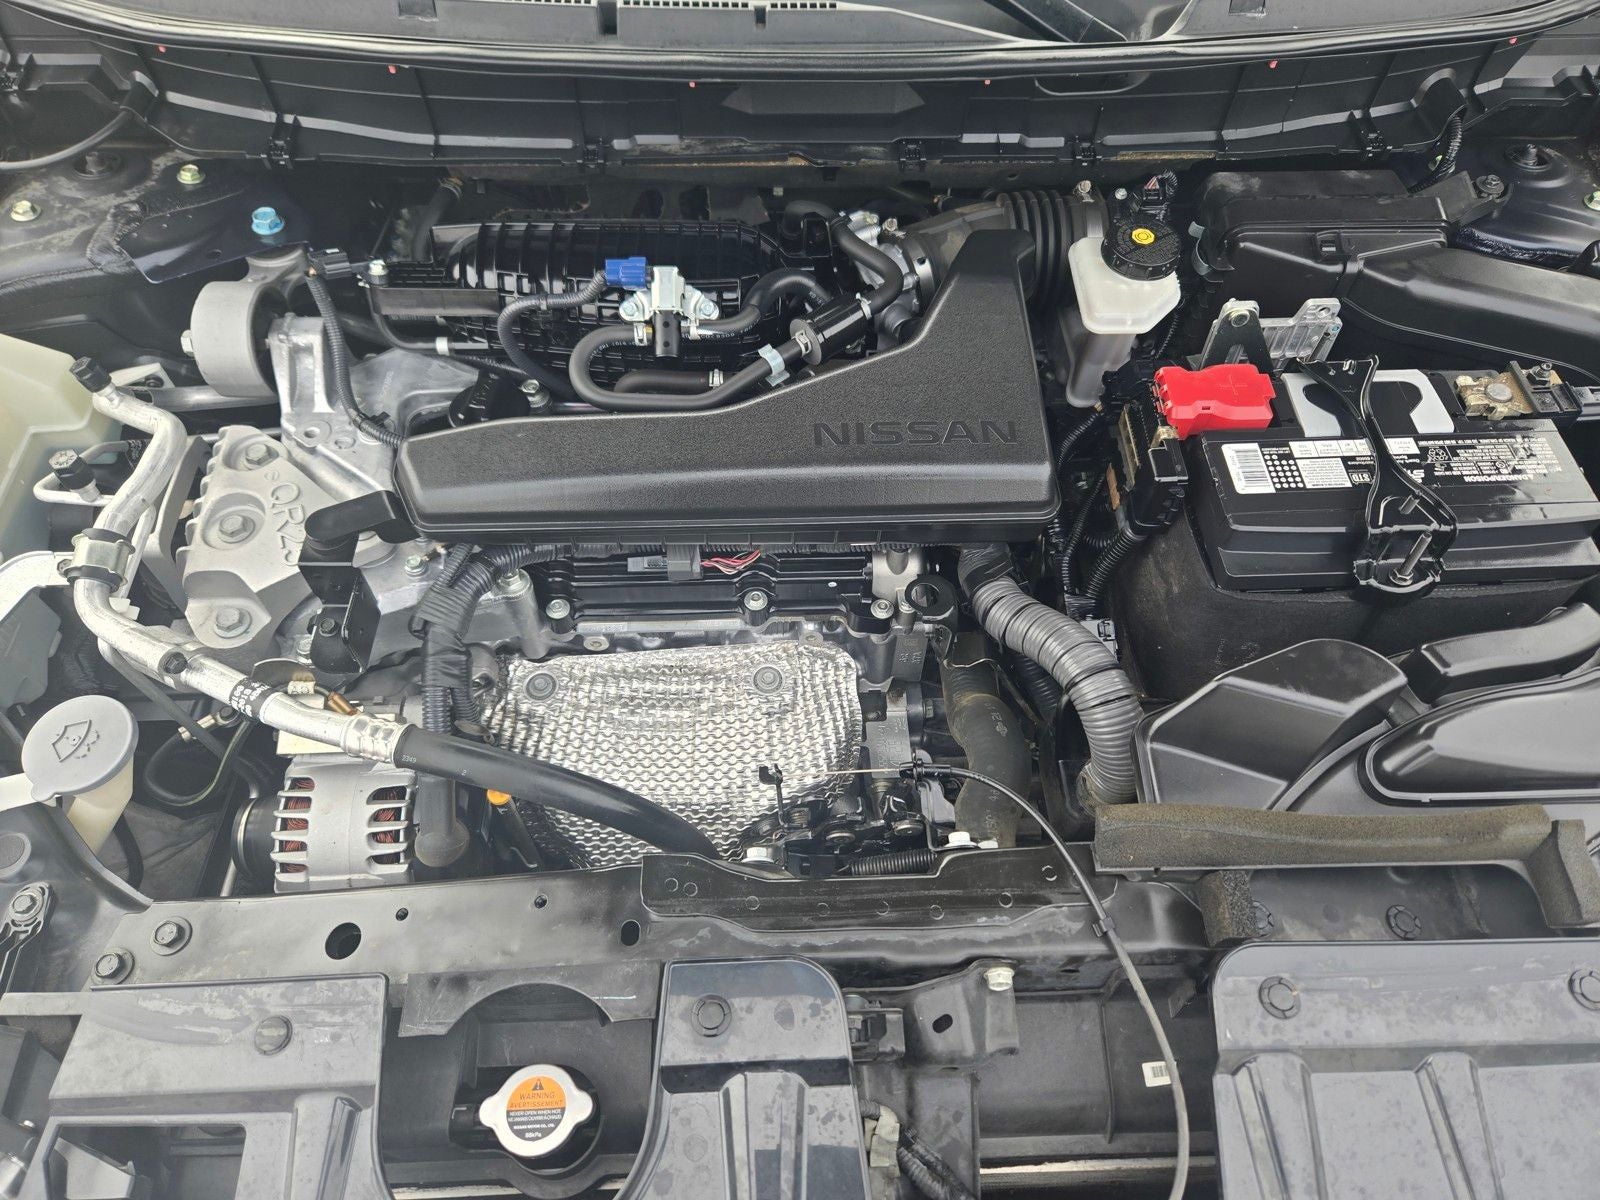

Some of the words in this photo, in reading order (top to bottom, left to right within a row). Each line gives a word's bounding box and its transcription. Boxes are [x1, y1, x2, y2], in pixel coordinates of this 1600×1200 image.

[813, 420, 1018, 446] NISSAN
[519, 1091, 555, 1100] WARNING
[510, 1100, 563, 1108] AVERTISSEMENT
